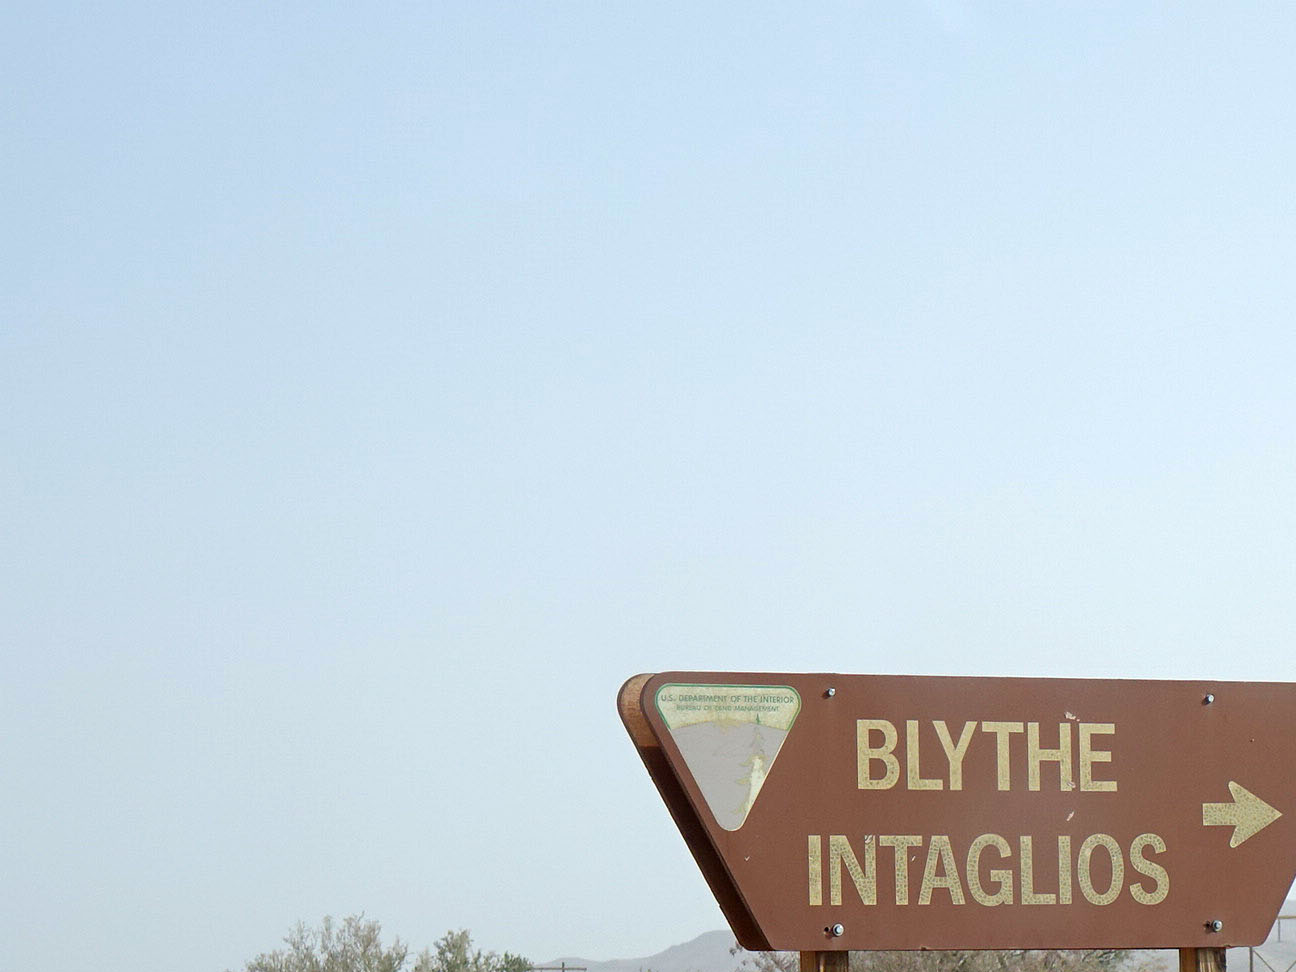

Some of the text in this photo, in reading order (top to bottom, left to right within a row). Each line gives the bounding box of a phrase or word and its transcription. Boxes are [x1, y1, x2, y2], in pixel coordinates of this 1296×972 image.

[678, 694, 728, 703] DEPARTMENT
[730, 695, 741, 703] OF
[743, 695, 760, 704] THE
[760, 695, 795, 704] INTERIOR
[856, 719, 1118, 792] BLYTHE
[807, 833, 1170, 907] INTAGLIOS
